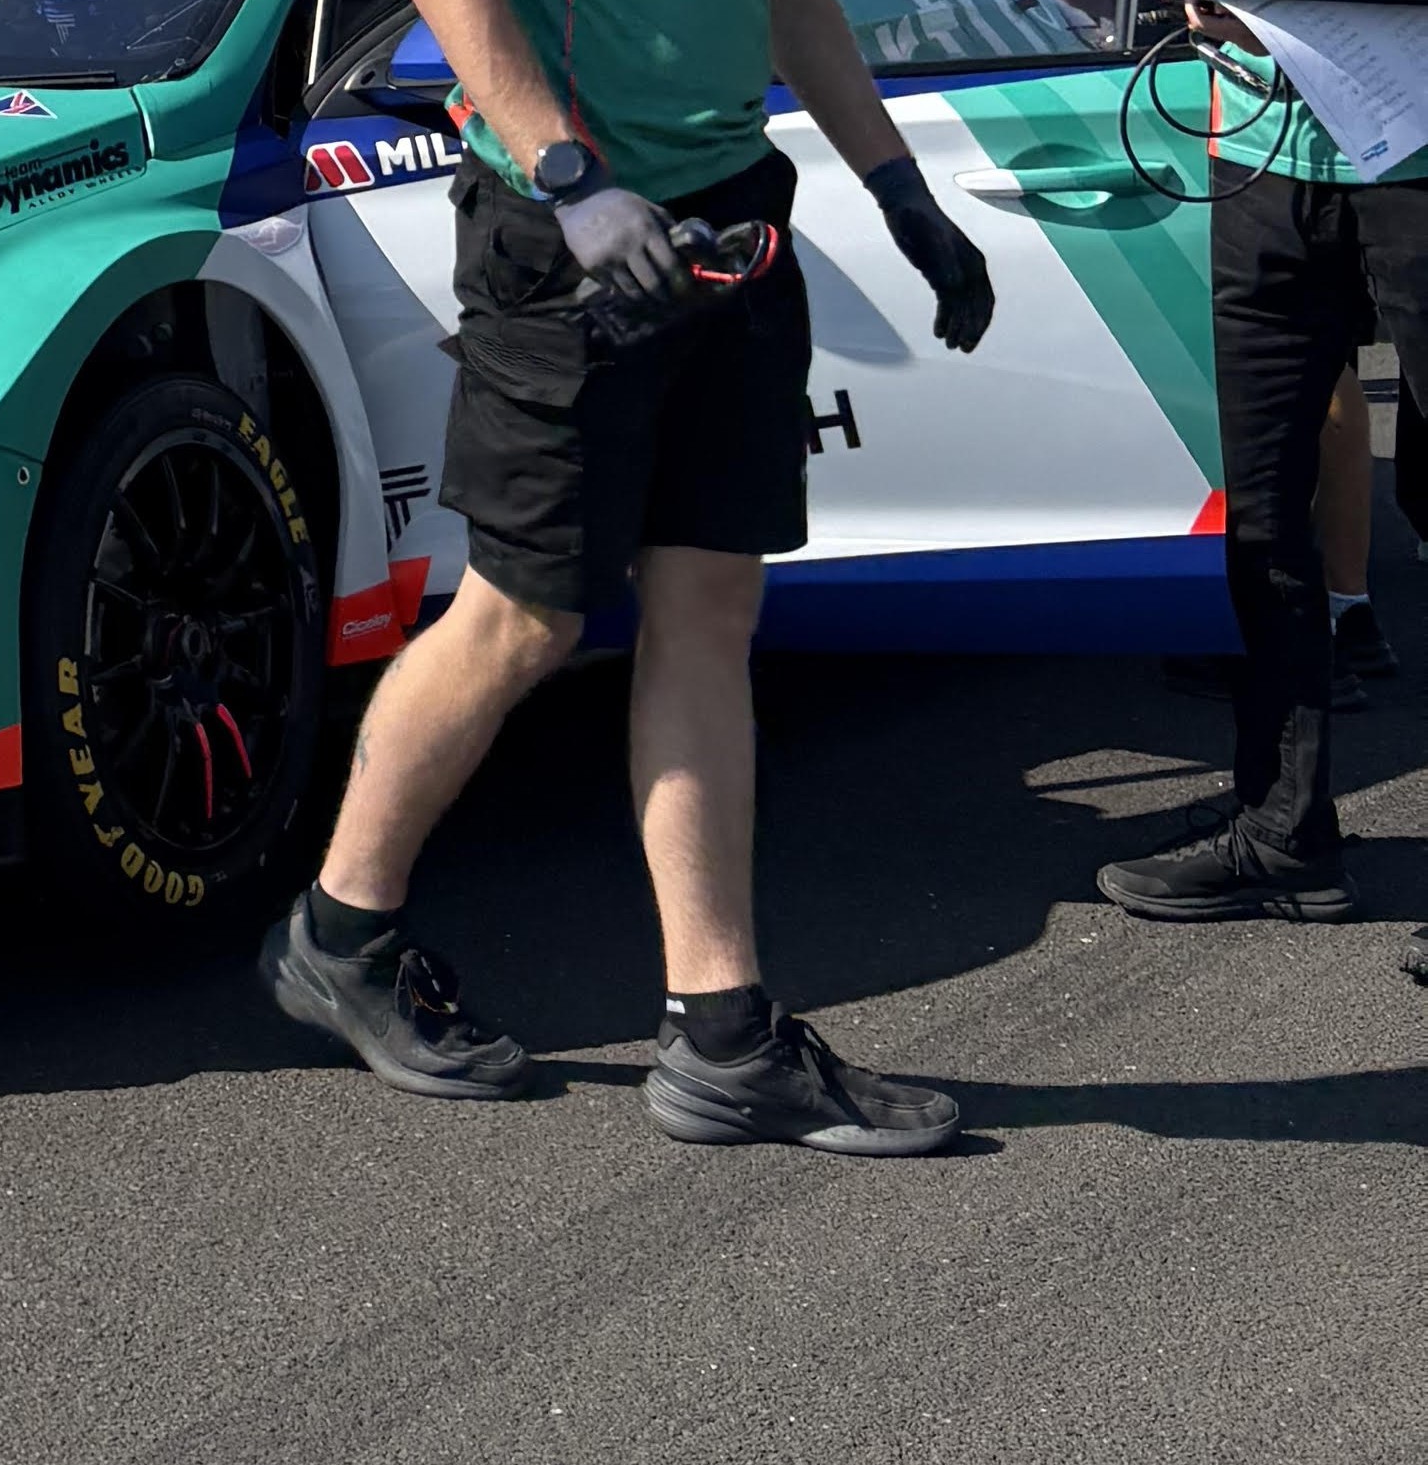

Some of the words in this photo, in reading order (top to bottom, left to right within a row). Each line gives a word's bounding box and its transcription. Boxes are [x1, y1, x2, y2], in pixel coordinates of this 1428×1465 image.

[375, 132, 469, 176] MIL
[28, 188, 75, 210] ALLOY
[805, 389, 862, 454] H
[238, 412, 310, 545] EAGLE
